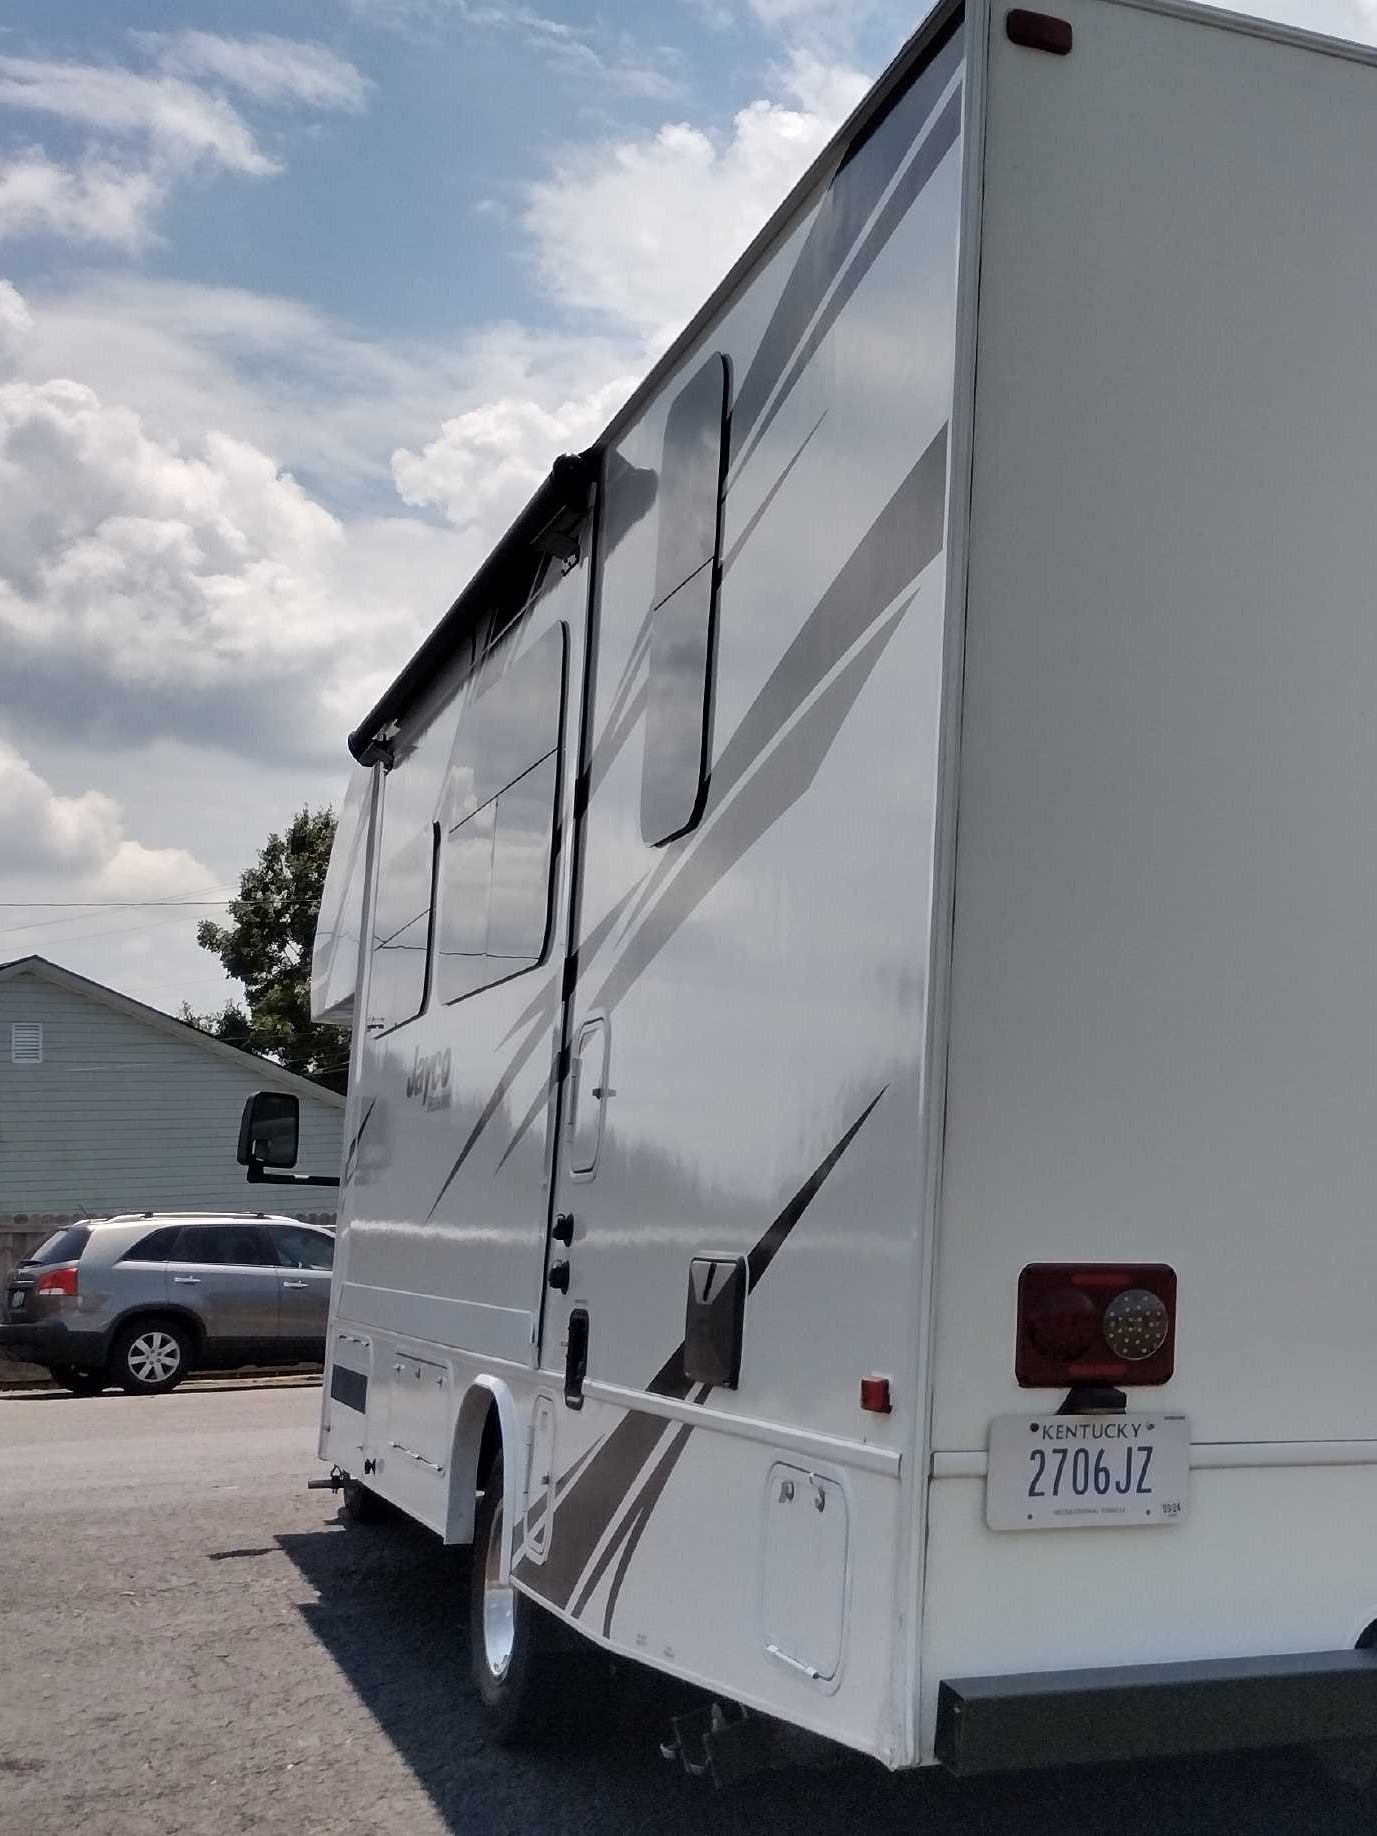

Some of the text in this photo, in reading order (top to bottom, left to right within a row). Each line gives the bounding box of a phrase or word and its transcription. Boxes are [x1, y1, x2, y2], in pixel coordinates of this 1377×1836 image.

[406, 1045, 451, 1106] Jayco
[1042, 1423, 1142, 1440] KENTUCKY
[1028, 1446, 1153, 1497] 2706JZ
